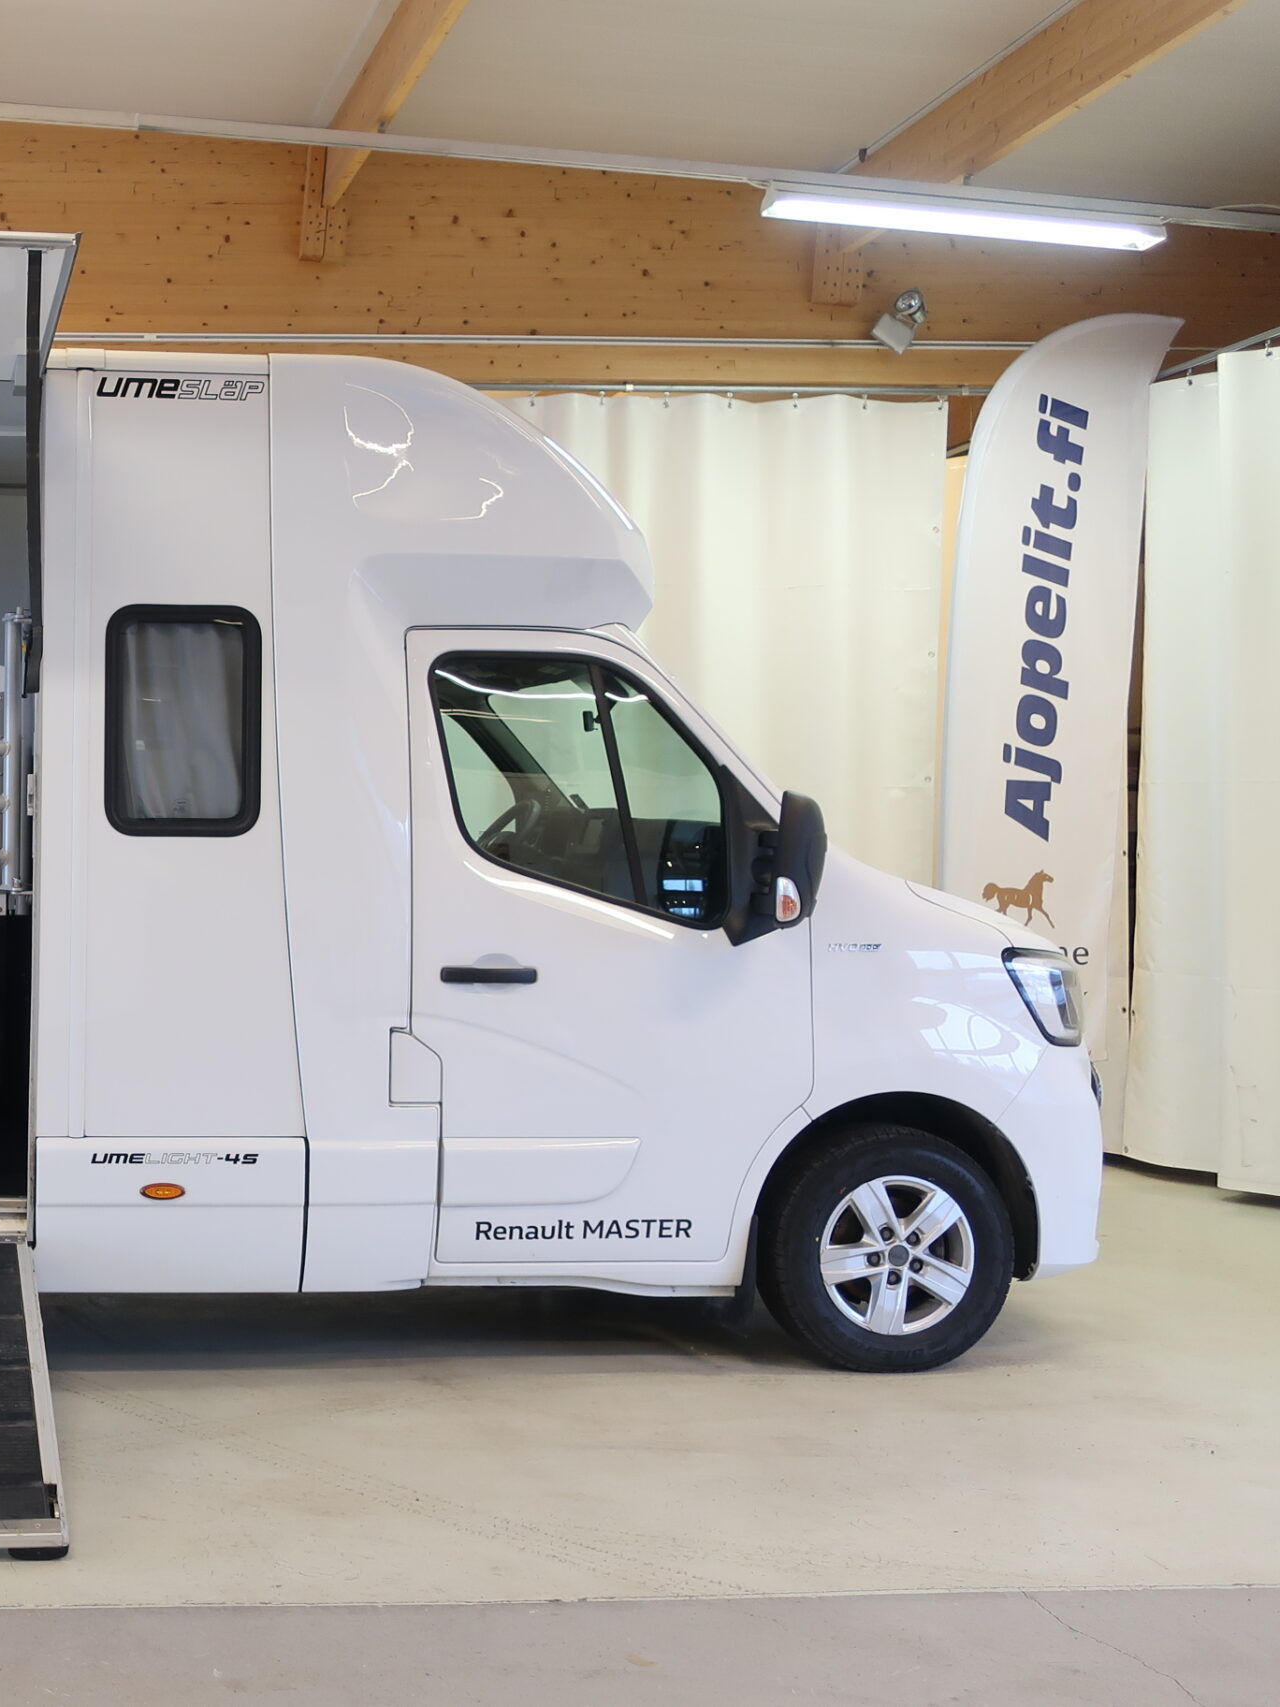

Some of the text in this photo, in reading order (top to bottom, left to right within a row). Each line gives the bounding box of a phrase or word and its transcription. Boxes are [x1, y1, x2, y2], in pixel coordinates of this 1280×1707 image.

[1002, 393, 1091, 843] Ajopelit.fi
[475, 1218, 693, 1241] Renault MASTER
